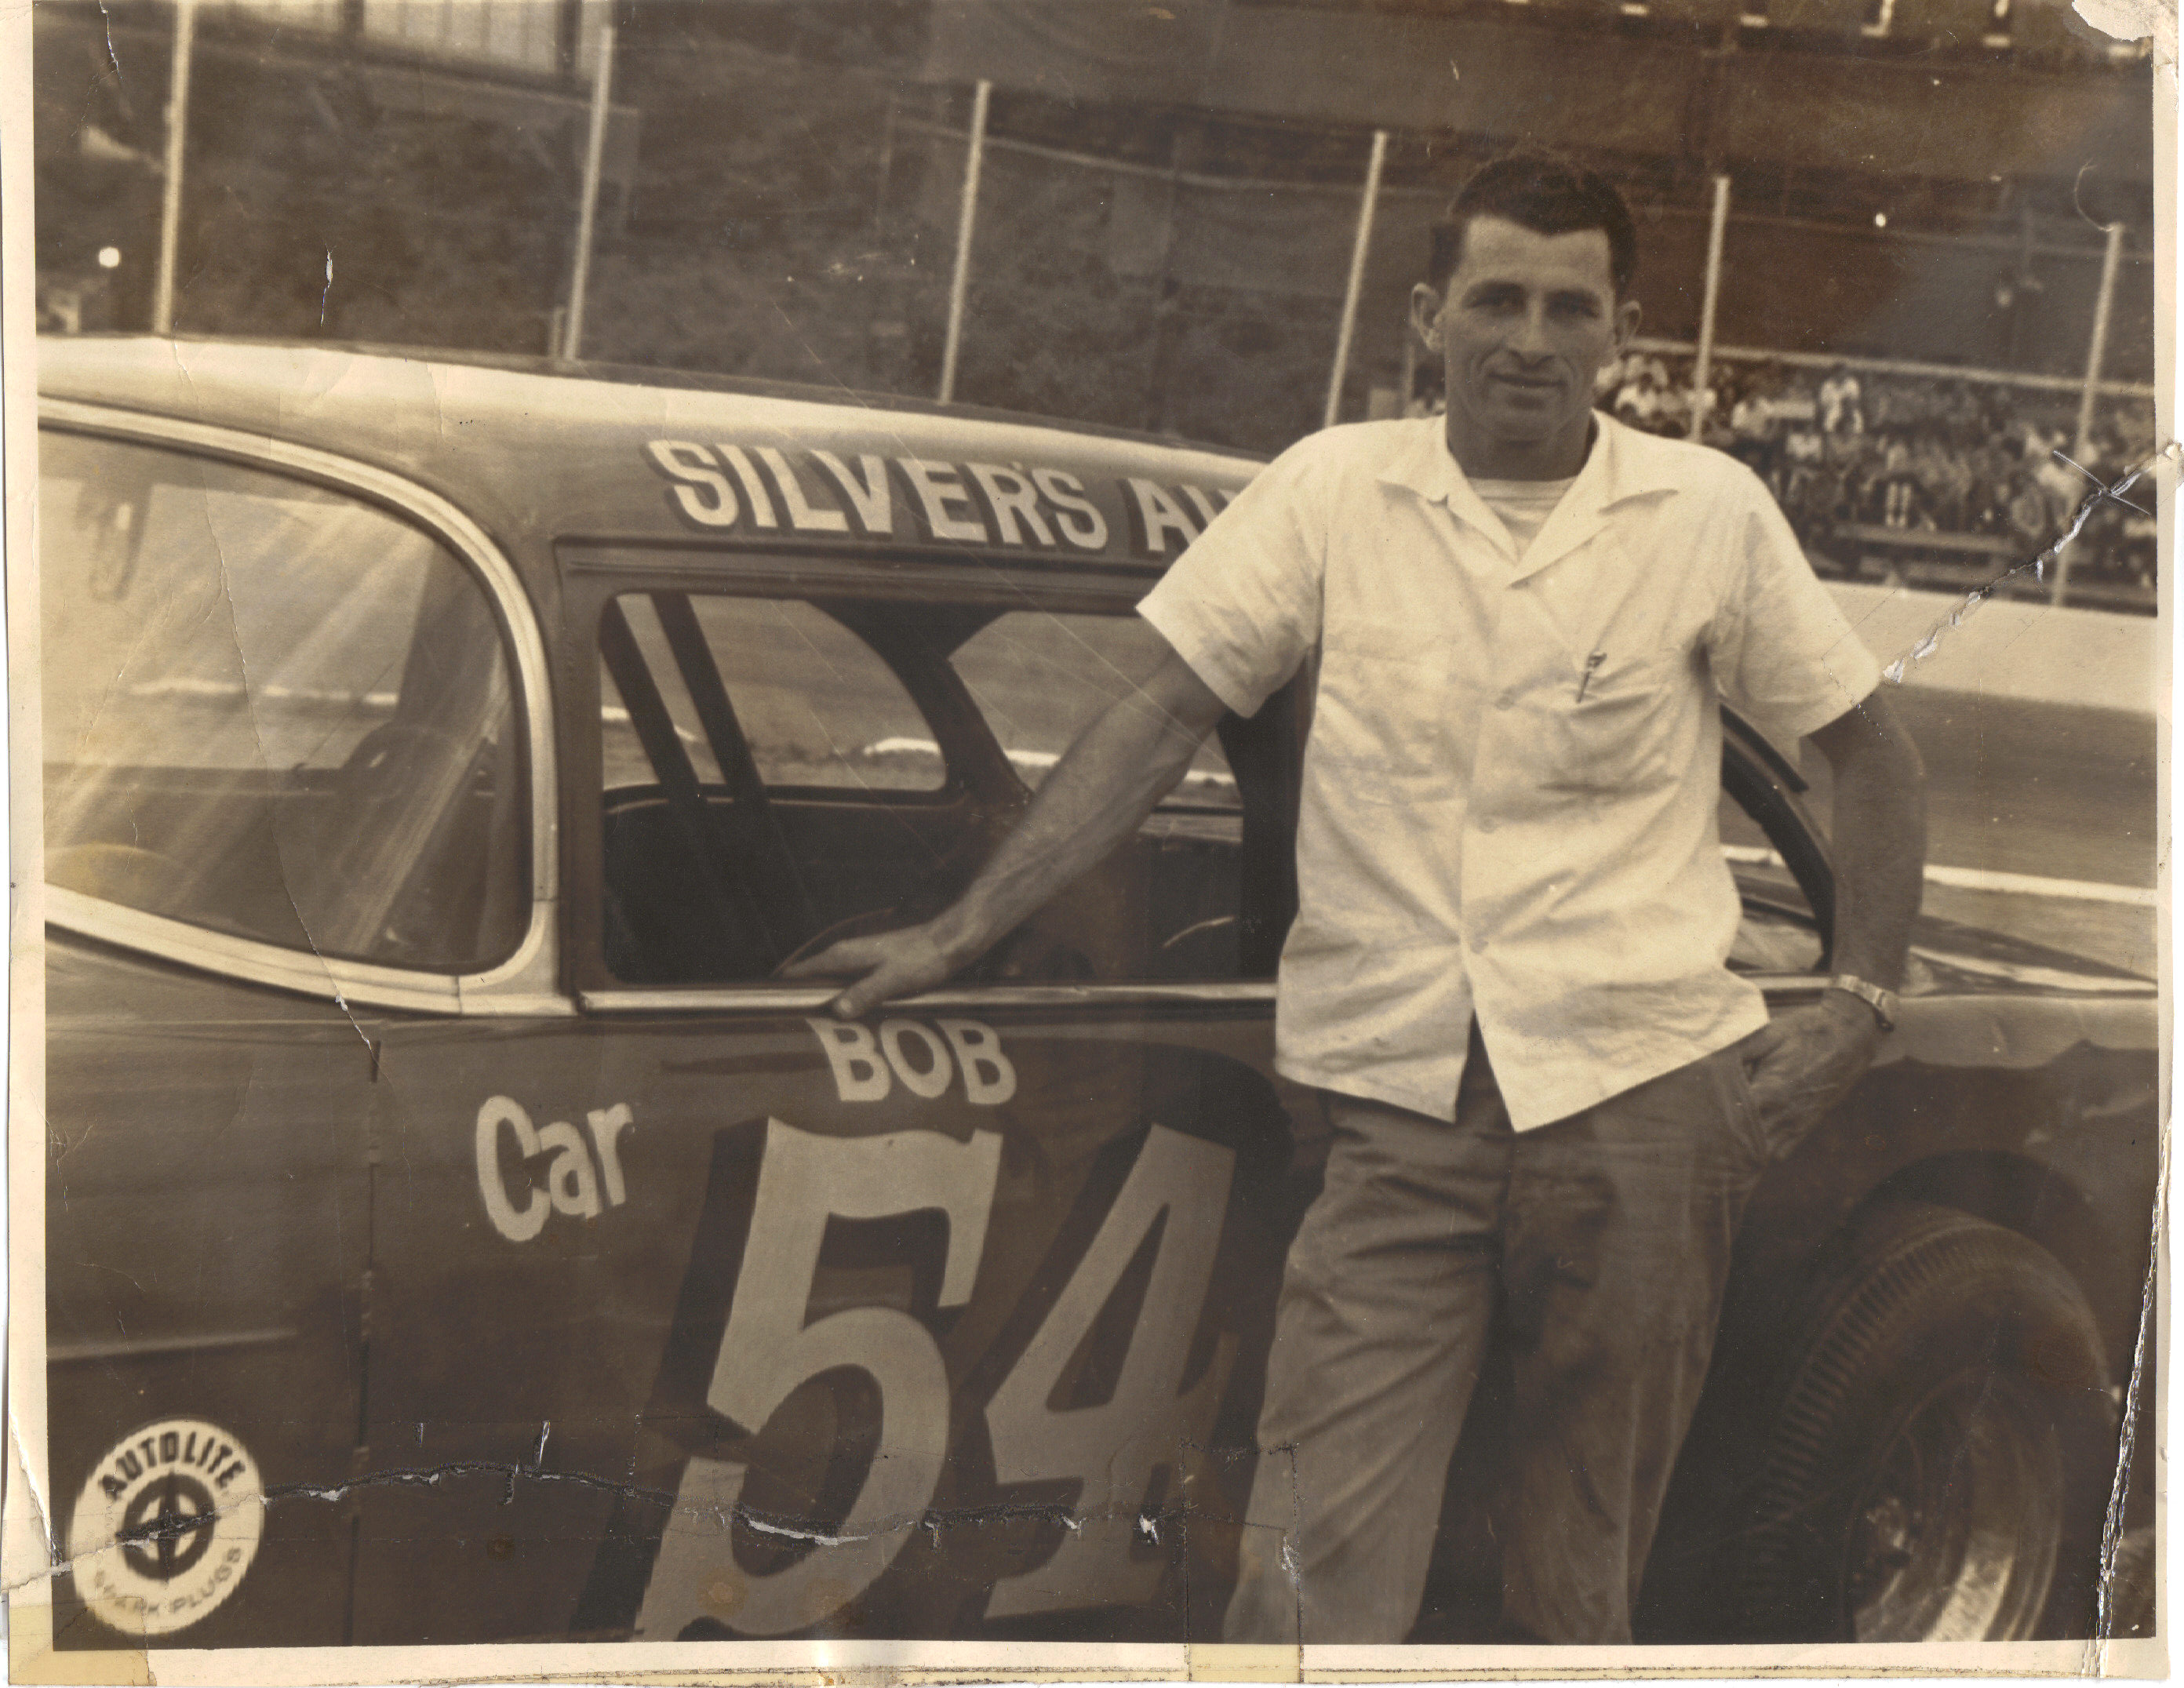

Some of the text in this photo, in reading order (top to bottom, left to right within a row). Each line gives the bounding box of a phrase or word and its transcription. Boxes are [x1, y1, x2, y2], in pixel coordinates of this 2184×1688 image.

[648, 440, 1107, 549] SILVER'S
[806, 1018, 1017, 1105] BOB
[476, 1095, 633, 1242] Car
[635, 1116, 1238, 1642] 54
[98, 1431, 246, 1500] AUTOLITE
[169, 1548, 242, 1613] PLUGS
